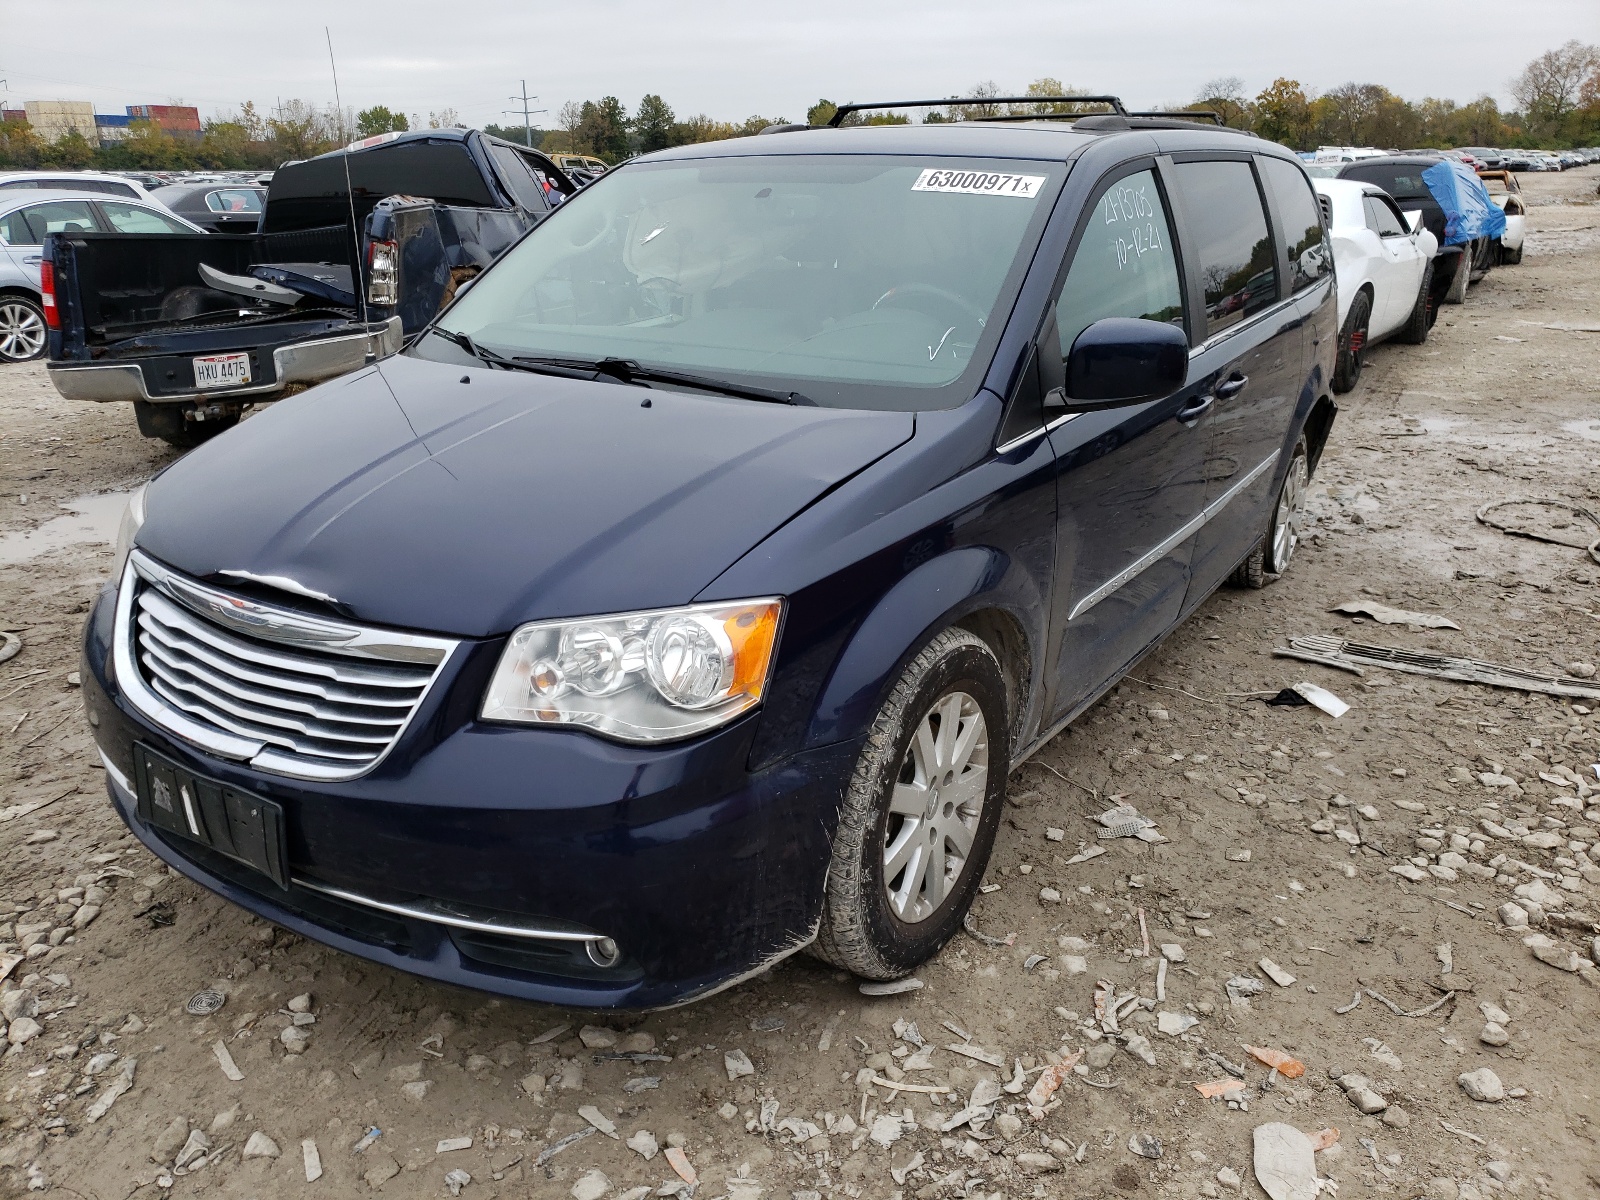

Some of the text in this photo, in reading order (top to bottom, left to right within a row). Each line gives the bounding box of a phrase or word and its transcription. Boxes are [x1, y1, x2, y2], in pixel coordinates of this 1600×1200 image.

[1115, 222, 1163, 270] 10-12-21
[198, 361, 246, 380] HXU 4475
[1090, 549, 1163, 605] CHRYSLER
